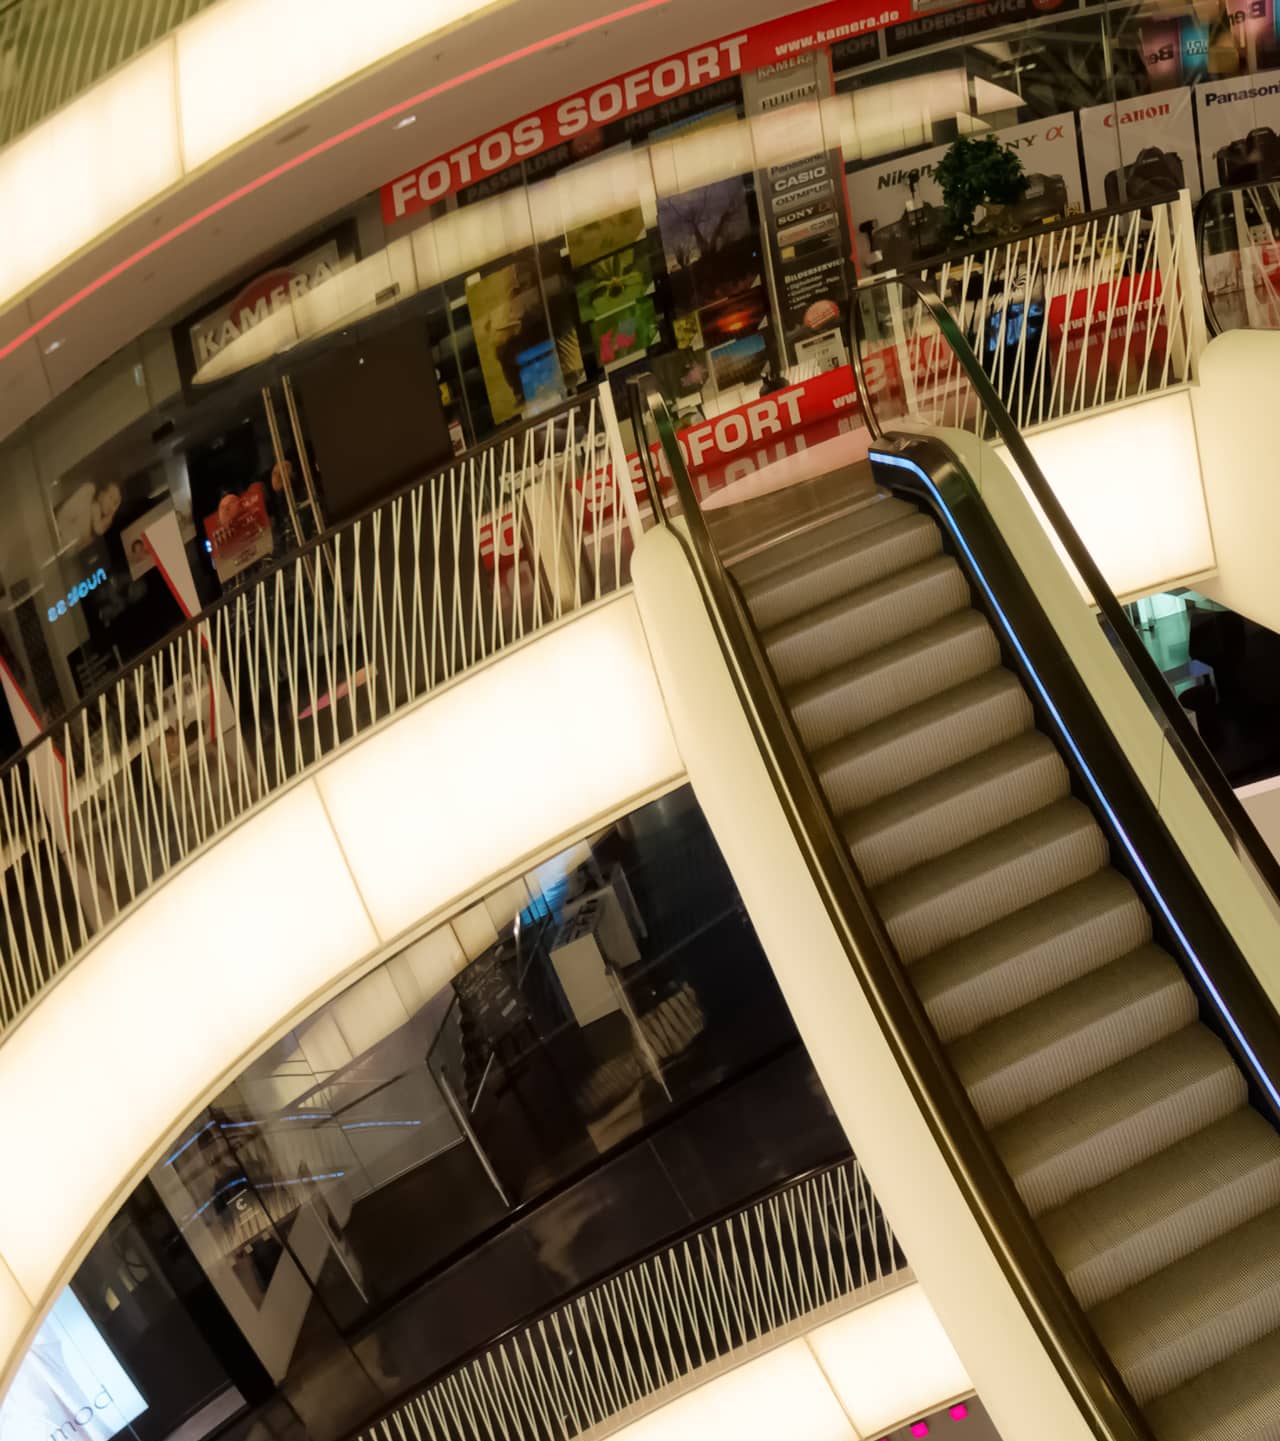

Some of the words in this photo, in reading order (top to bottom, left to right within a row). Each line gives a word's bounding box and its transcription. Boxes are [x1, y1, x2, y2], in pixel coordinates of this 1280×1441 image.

[774, 11, 899, 56] www.kamera.de
[391, 117, 544, 217] FOTOS
[556, 35, 748, 137] SOFORT
[1103, 103, 1170, 128] Canon
[774, 166, 827, 192] CASIO
[876, 163, 934, 191] Nikon
[777, 207, 815, 226] SONY
[198, 261, 336, 362] KAMERA
